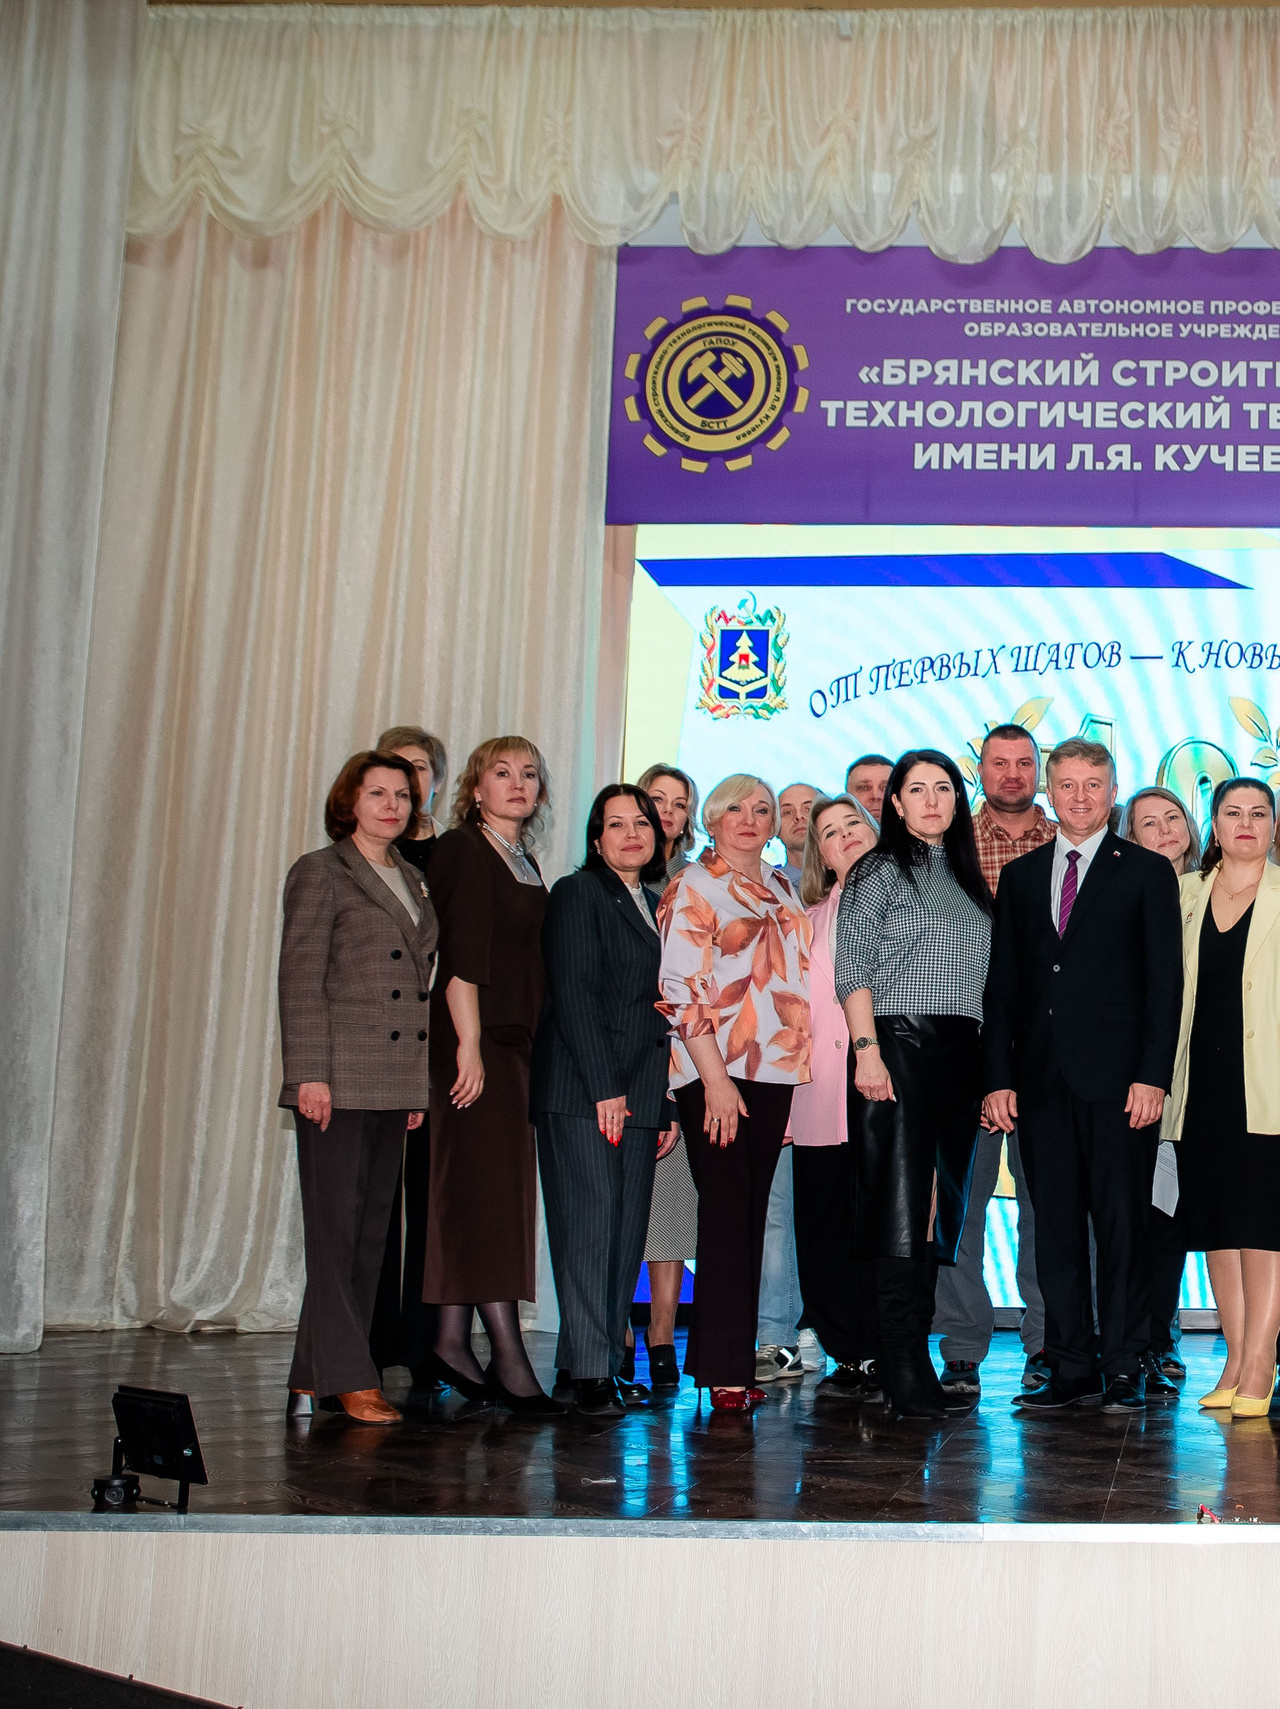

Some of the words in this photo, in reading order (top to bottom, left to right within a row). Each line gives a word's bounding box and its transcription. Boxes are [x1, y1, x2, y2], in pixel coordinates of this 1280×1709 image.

[845, 298, 1052, 315] ГОСУДАРСТВЕННОЕ
[1058, 299, 1204, 315] АВТОНОМНОЕ
[702, 336, 738, 348] ГАПОУ
[963, 322, 1173, 337] ОБРАЗОВАТЕЛЬНОЕ
[857, 352, 1100, 387] «БРЯНСКИЙ
[700, 419, 730, 430] БСТТ
[820, 394, 1231, 430] ТЕХНОЛОГИЧЕСКИЙ
[736, 413, 772, 442] Кучеева
[913, 442, 1056, 471] ИМЕНИ
[1065, 443, 1143, 472] Л.Я.
[808, 665, 863, 719] ОТ
[869, 644, 1006, 695] ПЕРВЫХ
[1010, 640, 1122, 676] ШАГОВ
[1171, 640, 1196, 674] К
